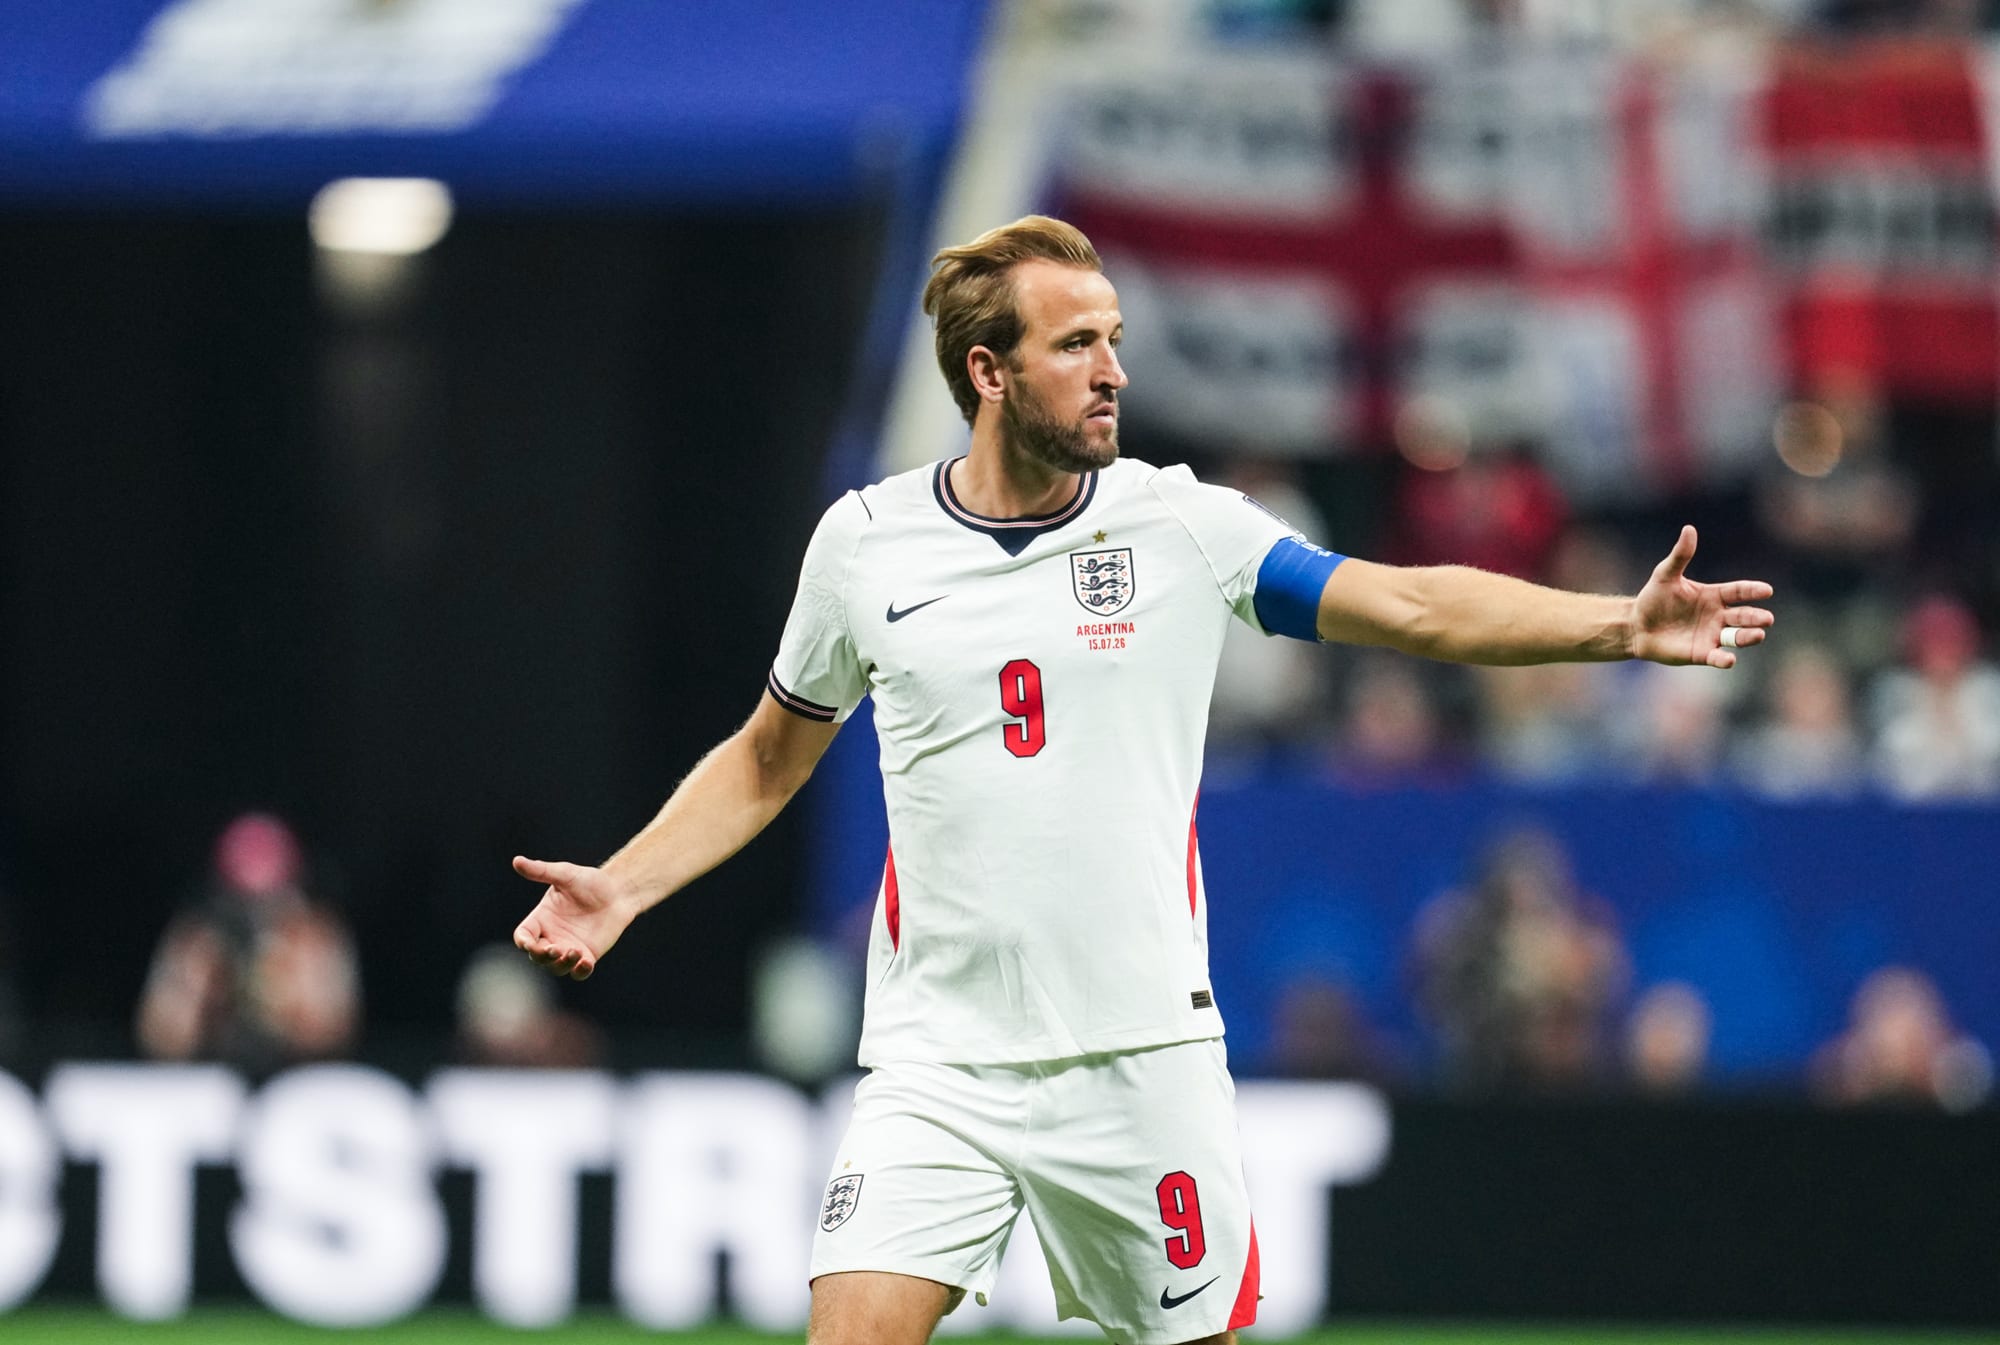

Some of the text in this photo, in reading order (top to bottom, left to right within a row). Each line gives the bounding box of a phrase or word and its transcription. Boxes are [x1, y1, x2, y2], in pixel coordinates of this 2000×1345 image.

[1076, 622, 1135, 636] ARGENTINA
[1089, 638, 1126, 650] 15.07.26
[999, 659, 1046, 757] 9
[1155, 1170, 1206, 1270] 9
